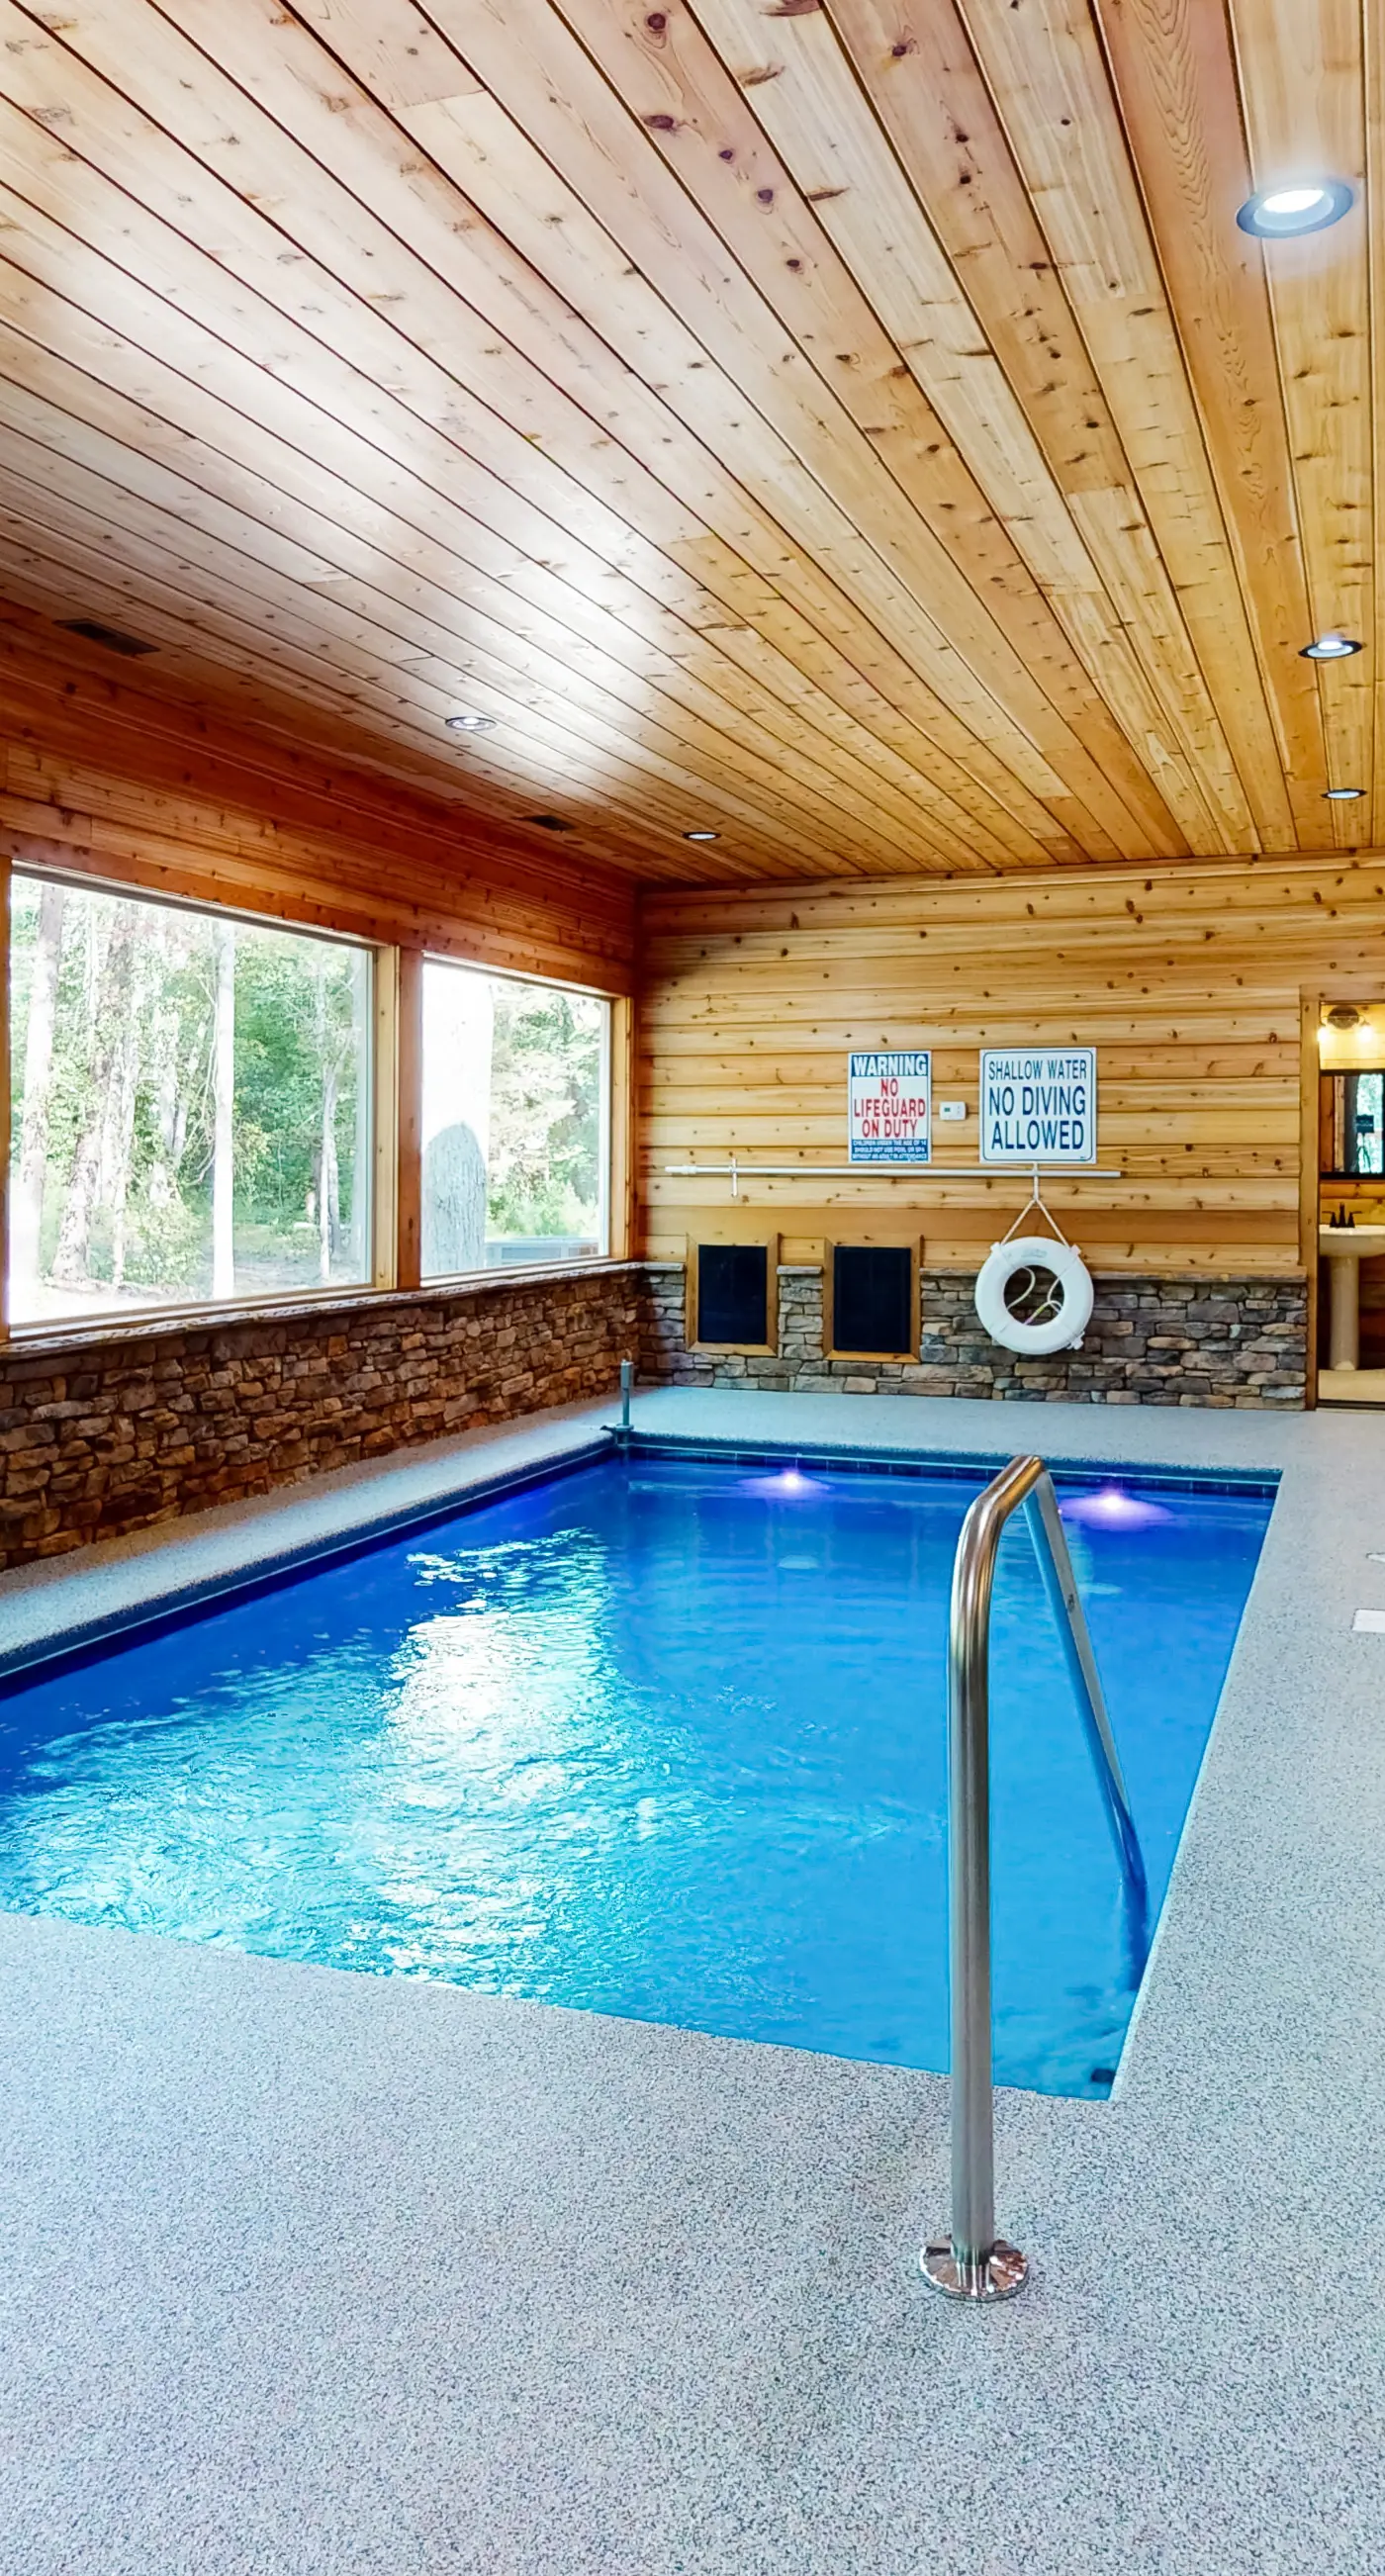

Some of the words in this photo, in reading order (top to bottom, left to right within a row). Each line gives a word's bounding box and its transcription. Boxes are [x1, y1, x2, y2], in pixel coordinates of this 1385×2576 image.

[853, 1055, 927, 1076] WARNING
[988, 1059, 1043, 1080] SHALLOW
[1048, 1059, 1087, 1080] WATER
[880, 1078, 898, 1097] NO
[854, 1098, 926, 1117] LIFEGUARD
[989, 1086, 1014, 1116] NO
[1022, 1085, 1086, 1116] DIVING
[862, 1119, 879, 1138] ON
[884, 1118, 917, 1138] DUTY
[991, 1120, 1084, 1150] ALLOWED
